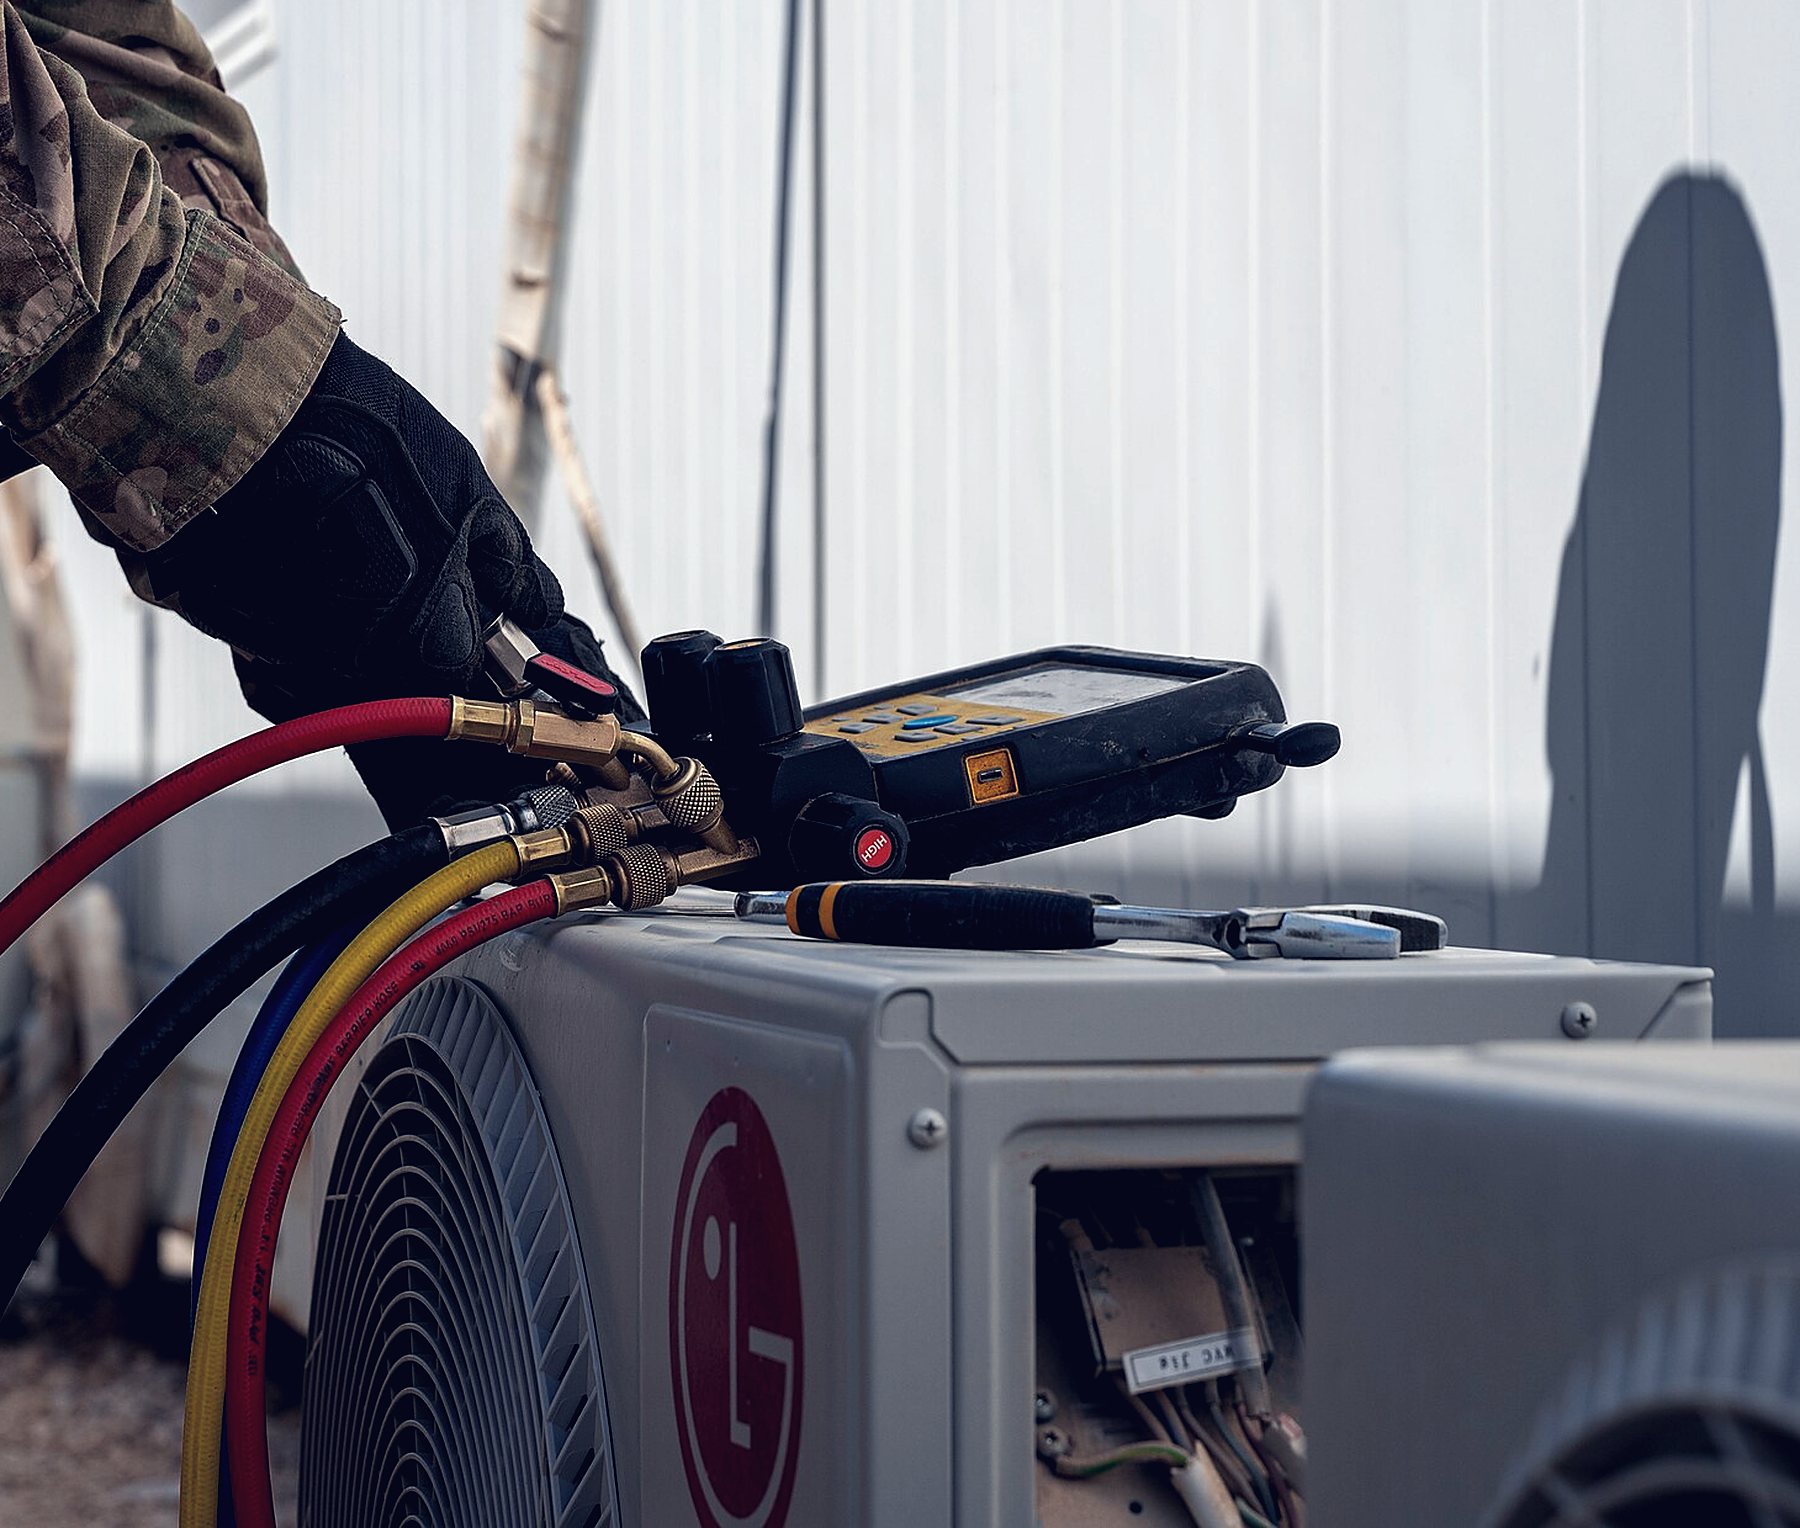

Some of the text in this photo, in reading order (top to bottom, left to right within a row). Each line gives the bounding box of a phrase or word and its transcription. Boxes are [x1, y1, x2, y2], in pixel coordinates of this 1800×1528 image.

[861, 835, 887, 862] HIGH
[501, 903, 523, 921] BAR
[336, 1008, 372, 1057] BARRIER
[373, 981, 398, 1010] HOSE
[678, 1121, 793, 1527] LG
